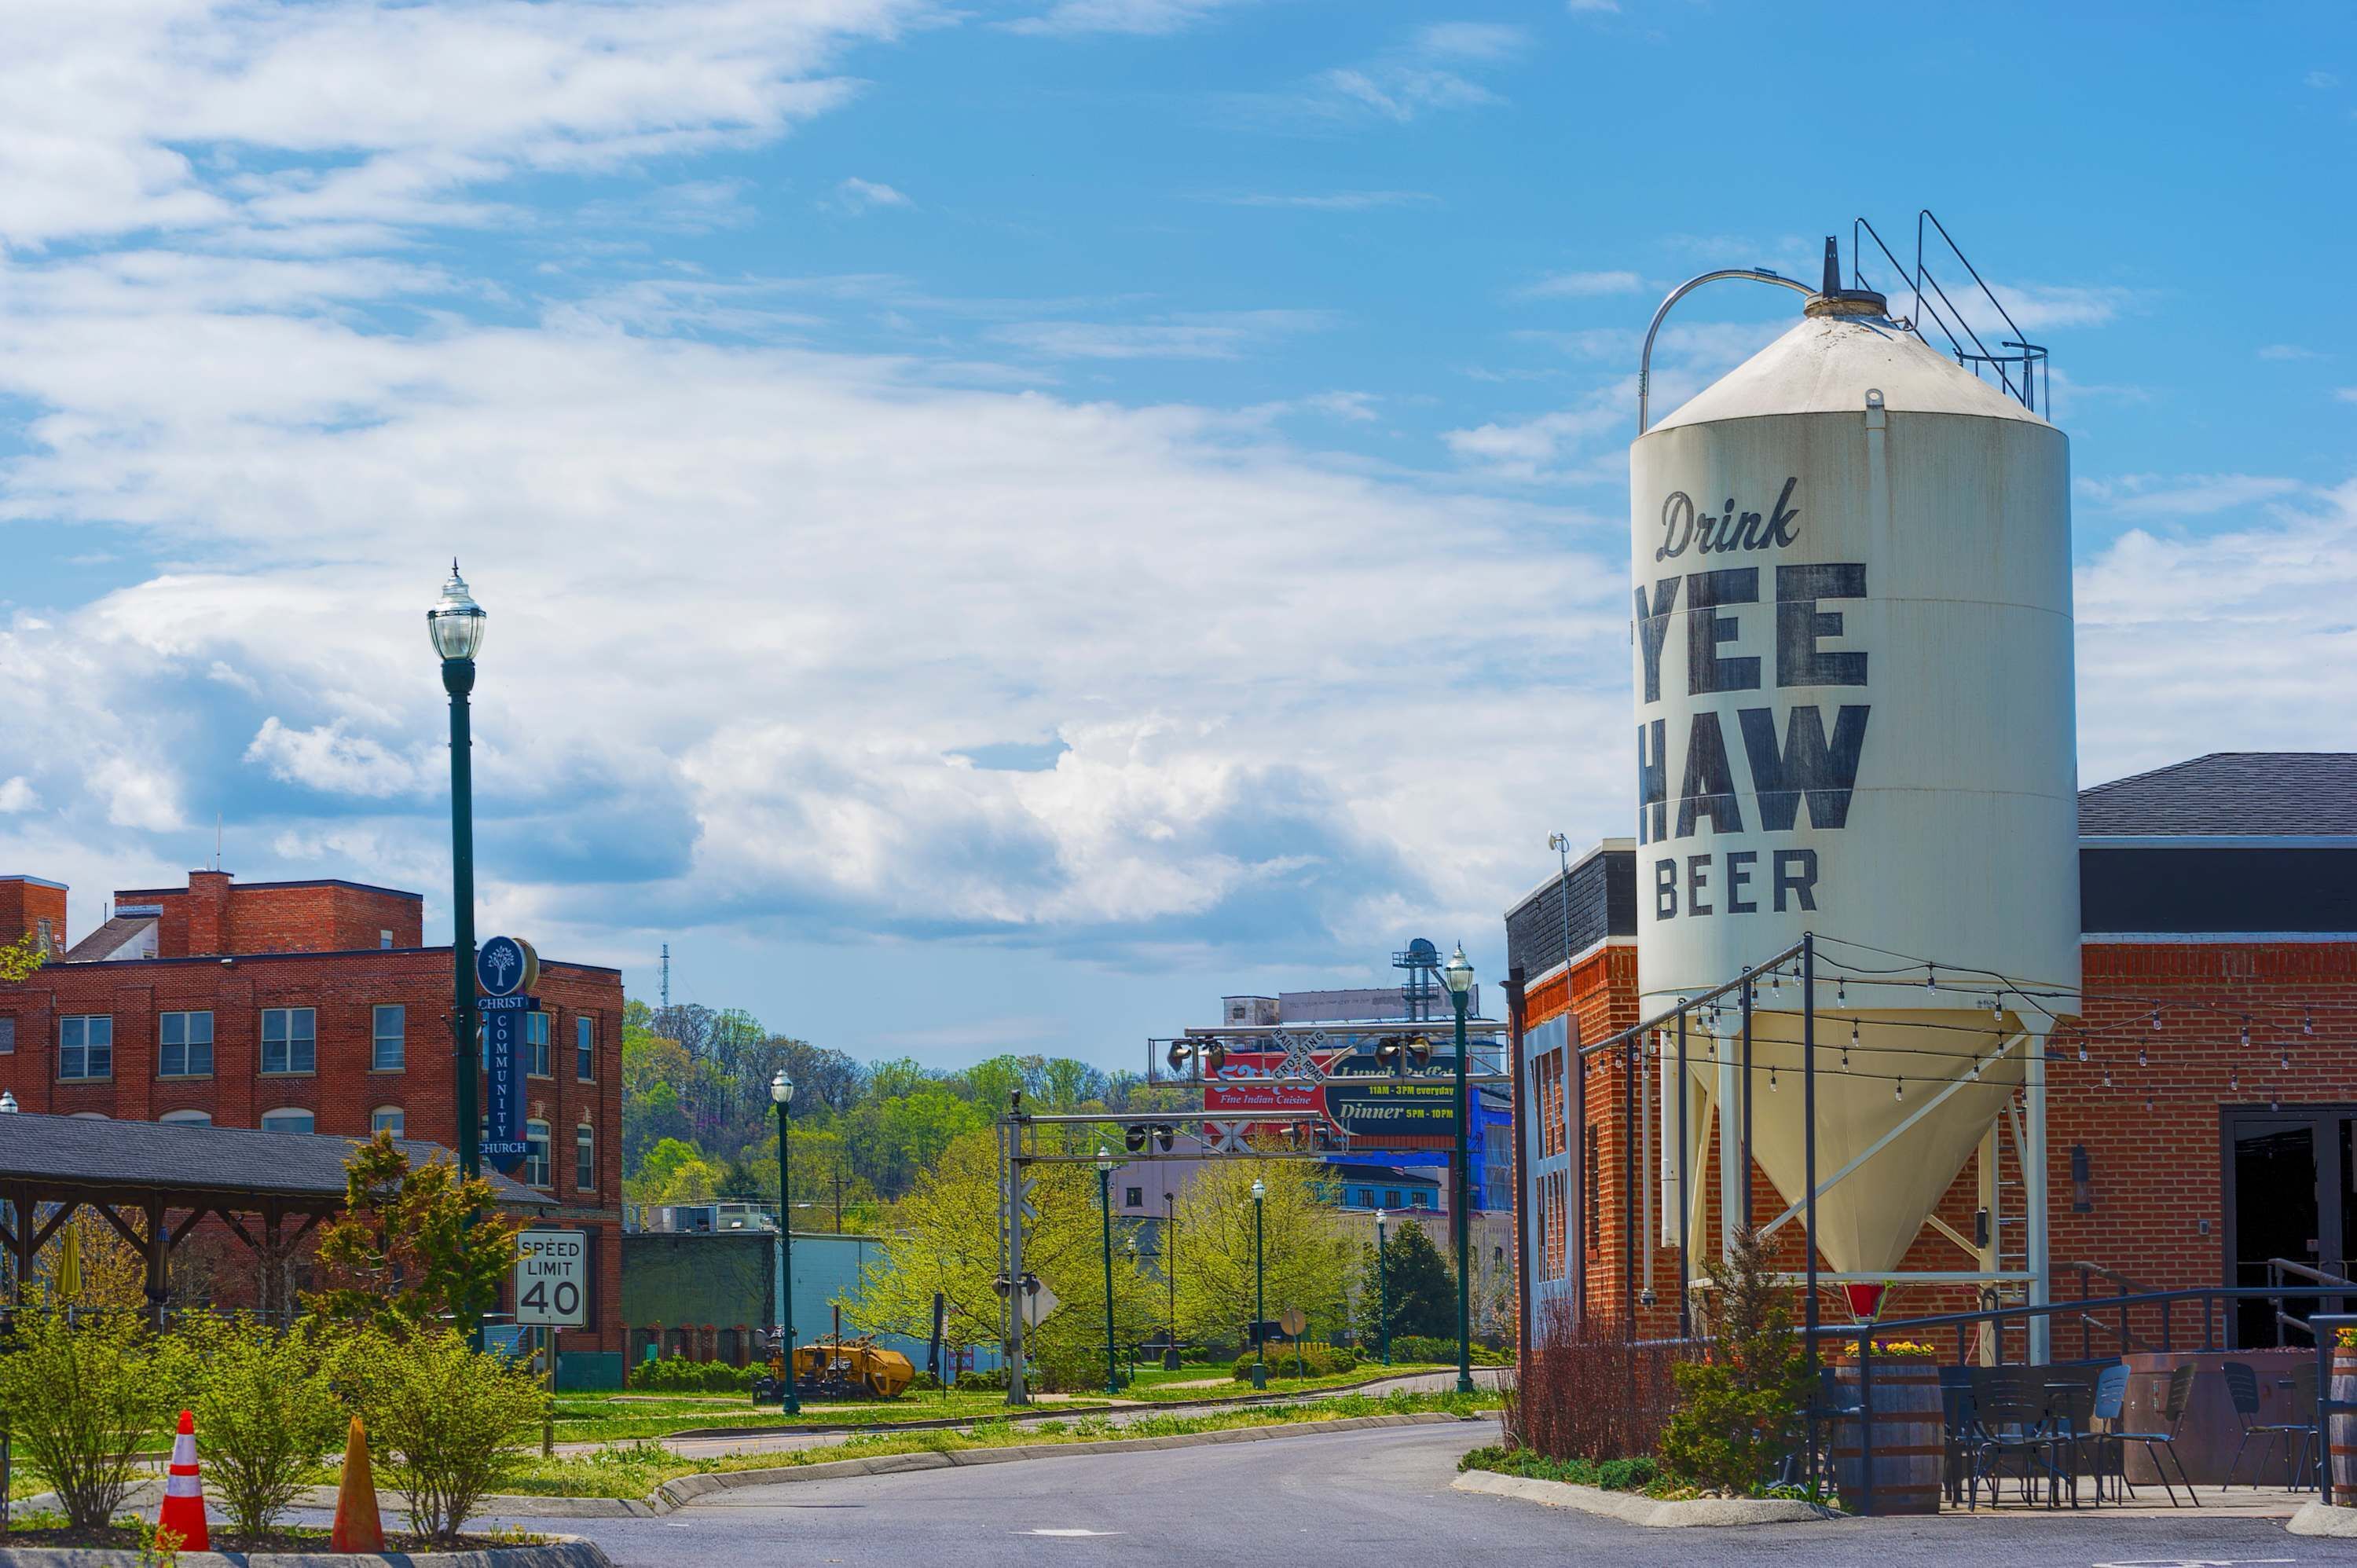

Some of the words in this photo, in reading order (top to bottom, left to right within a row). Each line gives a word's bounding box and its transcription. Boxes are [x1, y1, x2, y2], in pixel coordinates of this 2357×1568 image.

[1655, 477, 1800, 562] Drink
[1634, 562, 1868, 705] YEE
[1638, 705, 1871, 845] HAW
[1655, 849, 1818, 921] BEER
[478, 997, 523, 1009] CHRIST
[496, 1015, 508, 1137] COMMUNITY
[1273, 1029, 1293, 1052] RAIL
[1303, 1061, 1324, 1083] ROAD
[1274, 1031, 1324, 1079] CROSSING
[1220, 1095, 1241, 1104] Fine
[1244, 1095, 1274, 1104] Indian
[1276, 1095, 1311, 1105] Cuisine
[1340, 1103, 1404, 1119] Dinner
[1406, 1109, 1424, 1118] 5PM
[1432, 1109, 1453, 1118] 10PM
[1369, 1086, 1390, 1095] 11AM
[1396, 1086, 1414, 1095] 3PM
[1416, 1086, 1453, 1096] everyday
[522, 1242, 580, 1257] SPEED
[527, 1262, 573, 1276] LIMIT
[520, 1280, 580, 1316] 40
